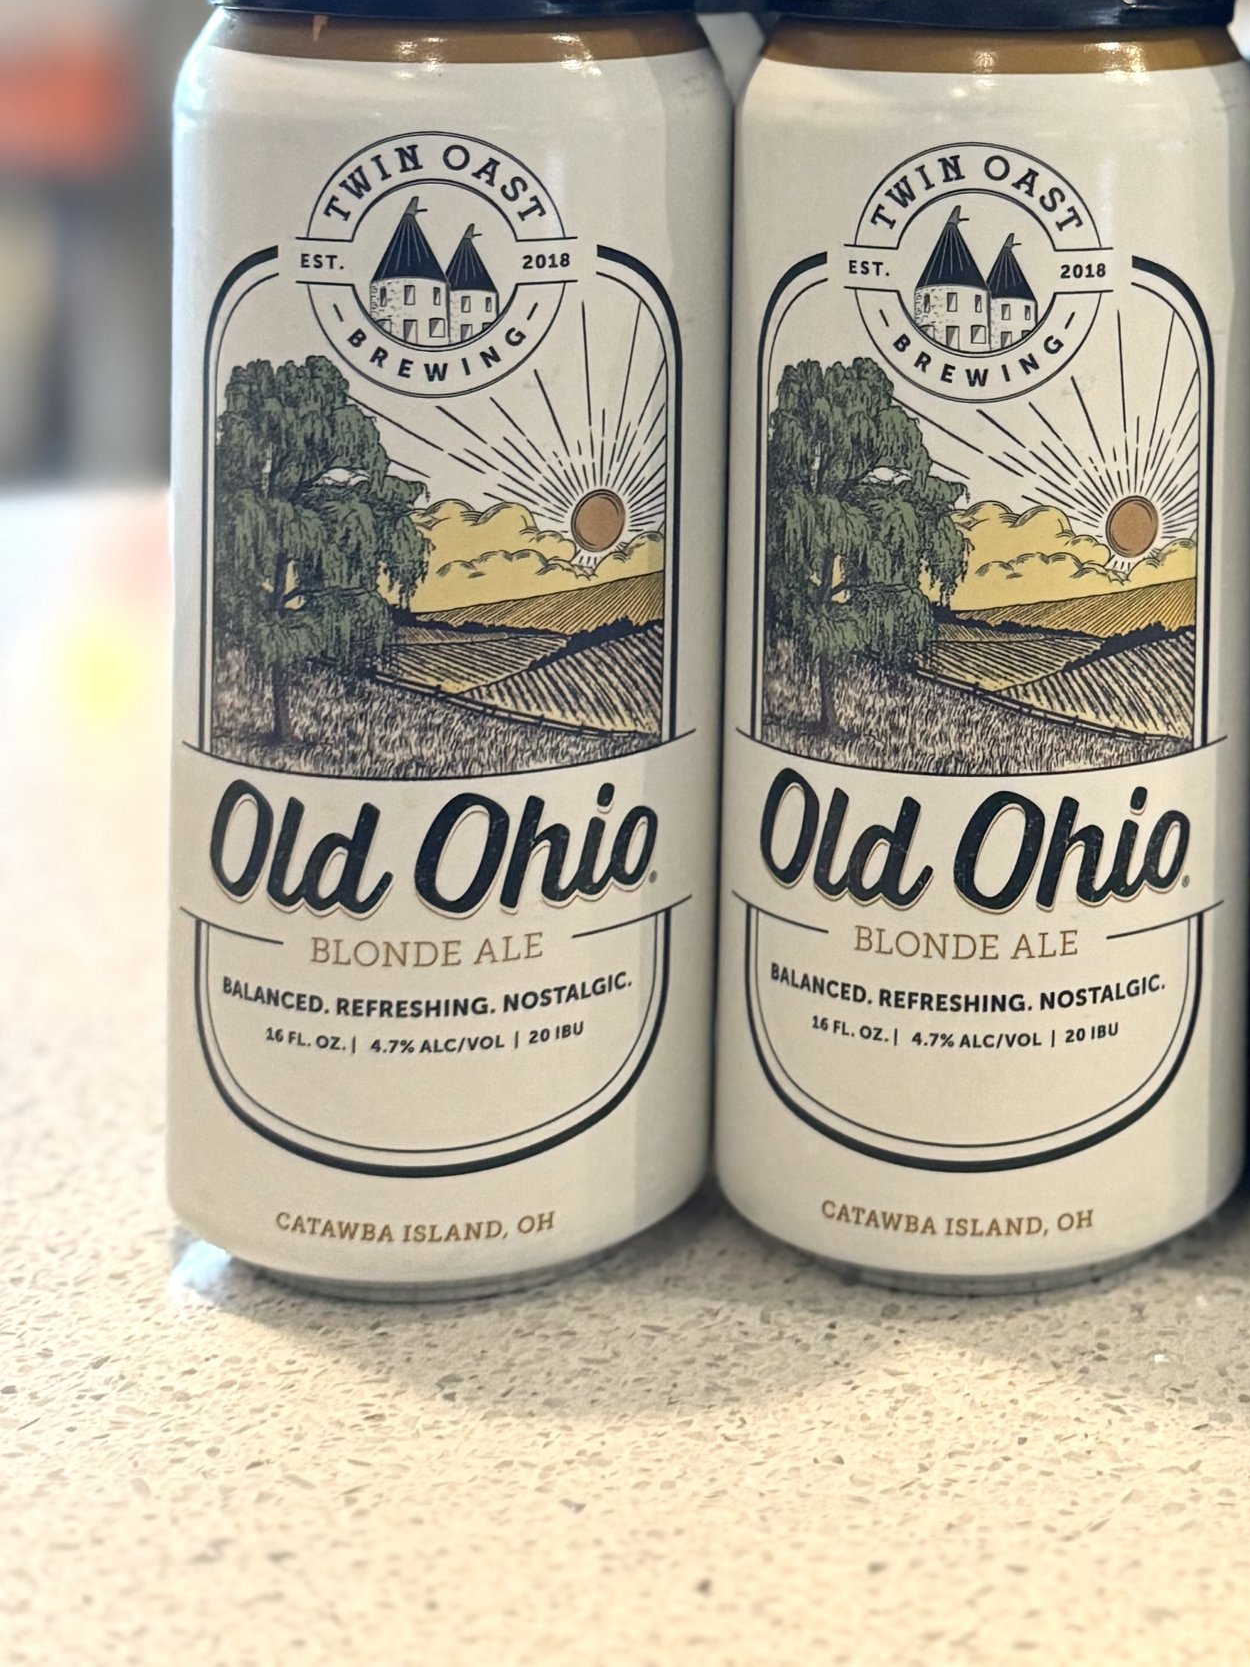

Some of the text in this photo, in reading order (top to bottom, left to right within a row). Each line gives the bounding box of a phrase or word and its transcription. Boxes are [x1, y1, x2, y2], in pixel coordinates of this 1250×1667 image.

[323, 144, 546, 221] TWIN OAST
[870, 155, 1084, 231] TWIN OAST
[300, 253, 570, 269] EST. 2018
[849, 260, 1106, 279] EST. 2018
[347, 327, 526, 382] BREWING
[893, 333, 1064, 387] BREWING
[209, 778, 394, 916] Old
[760, 767, 934, 908] Old
[310, 932, 544, 967] BLONDE ALE
[854, 925, 1078, 960] BLONDE ALE
[223, 971, 632, 1019] BALANCED. REFRESHING. NOSTALGIC.
[771, 962, 1165, 1013] BALANCED. REFRESHING. NOSTALGIC.
[266, 1021, 584, 1054] 16 FL. OZ. 4.7% ALC/VOL 20 IBU
[812, 1015, 1118, 1049] 16 FL. OZ. 4.7% ALC/VOL 20 IBU
[276, 1210, 556, 1243] CATAWBA ISLAND, OH
[821, 1199, 1094, 1237] CATAWBA ISLAND, OH
